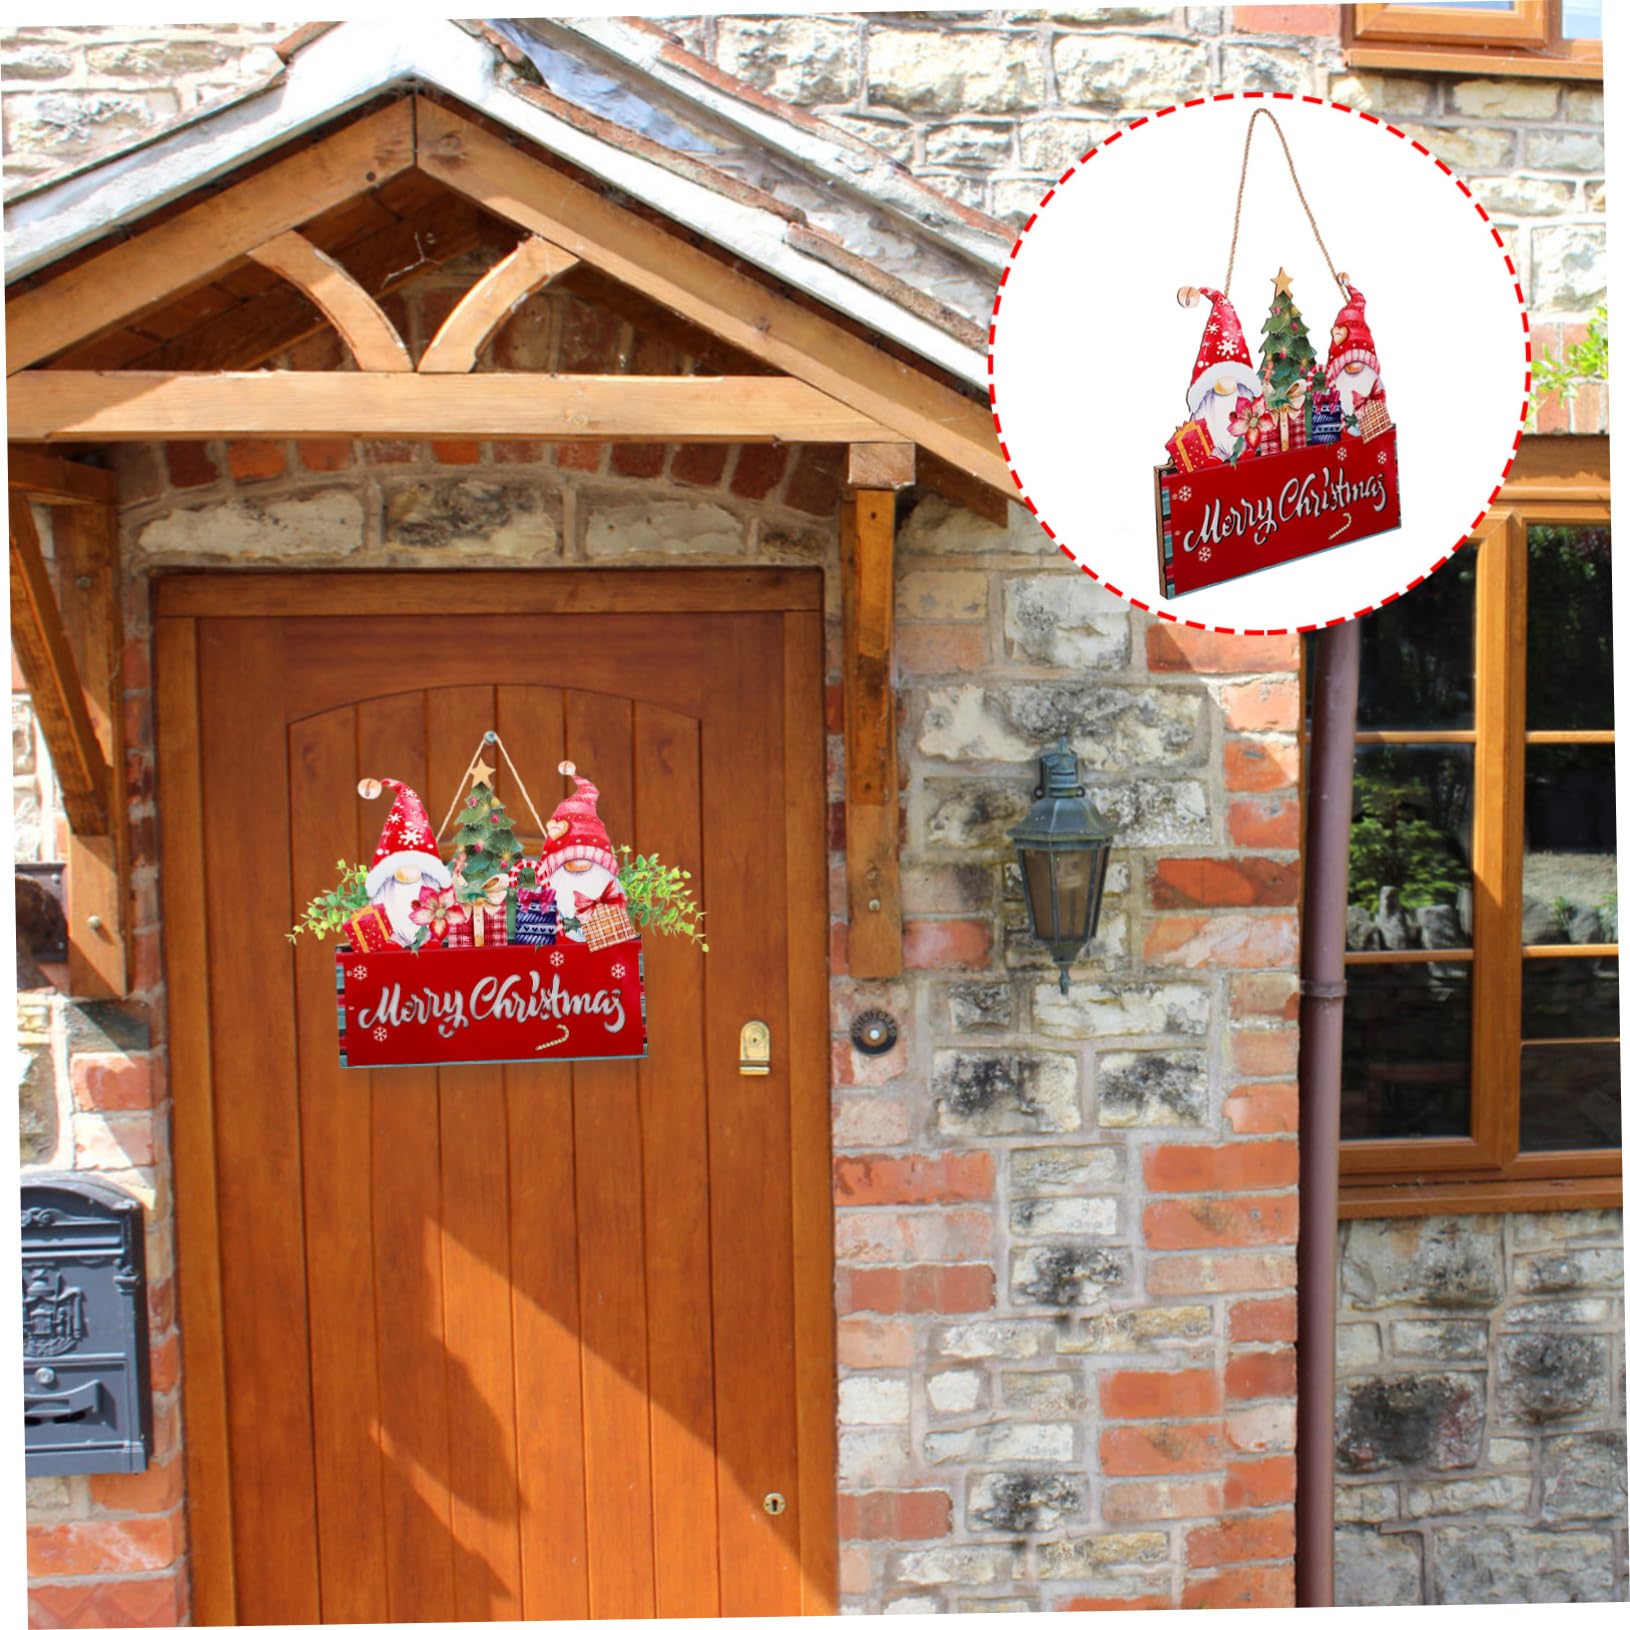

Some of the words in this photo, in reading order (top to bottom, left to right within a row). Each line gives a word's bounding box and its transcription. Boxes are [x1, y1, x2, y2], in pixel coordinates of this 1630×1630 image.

[1183, 496, 1277, 552] Merry
[1279, 467, 1386, 523] Christmas
[358, 983, 469, 1038] Merry
[469, 970, 626, 1033] Christmas
